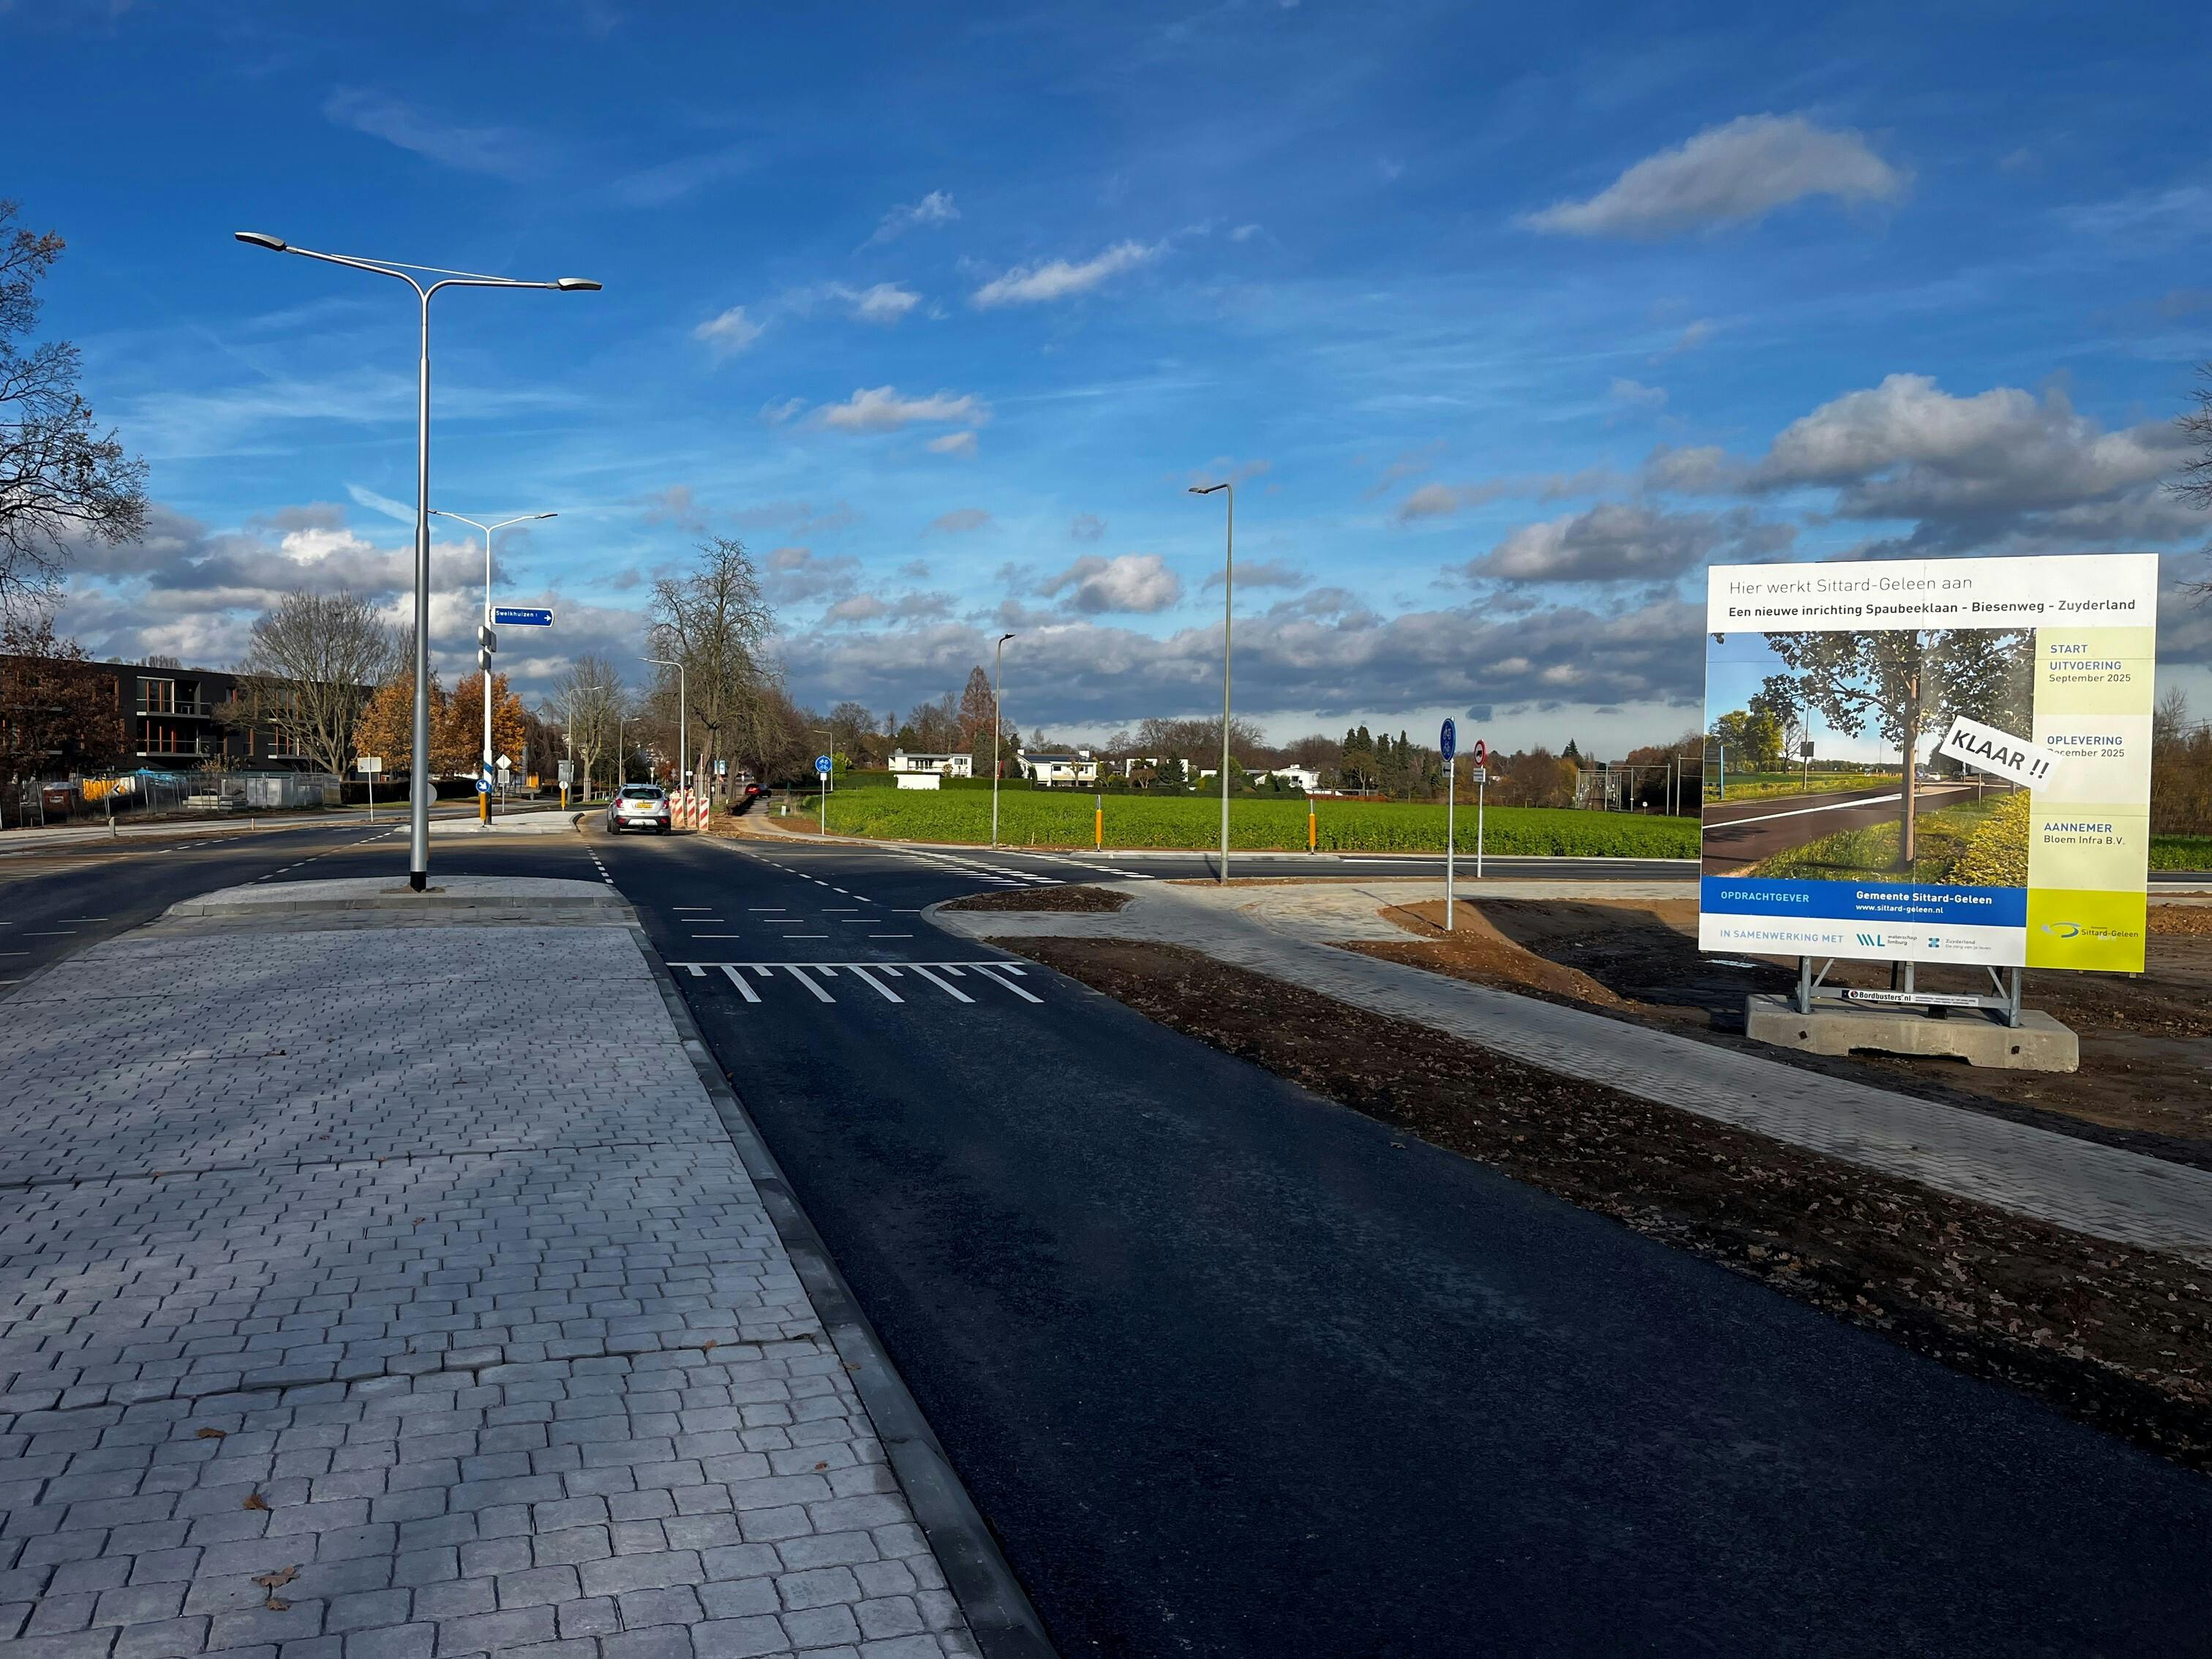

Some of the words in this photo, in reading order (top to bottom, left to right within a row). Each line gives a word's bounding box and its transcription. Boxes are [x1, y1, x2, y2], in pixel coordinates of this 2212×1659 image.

[1729, 581, 1763, 594] Hier
[1767, 580, 1812, 593] werkt
[1816, 576, 1936, 592] Sittard-Geleen
[1941, 578, 1973, 590] aan
[1728, 607, 1751, 617] Een
[1755, 606, 1799, 617] nieuwe
[1802, 604, 1862, 617] inrichting
[1865, 602, 1958, 616] Spaubeeklaan
[1971, 601, 2045, 614] Biesenweg
[2058, 599, 2136, 613] Zuyderland
[2050, 644, 2088, 653] START
[2050, 661, 2122, 671] UITVOERING
[2049, 674, 2104, 684] September
[2107, 674, 2132, 682] 2025
[2047, 736, 2123, 745] OPLEVERING
[1951, 729, 2025, 770] KLAAR
[2029, 759, 2050, 779] !!
[2101, 748, 2125, 757] 2025
[2044, 822, 2113, 832] AANNEMER
[2044, 835, 2076, 843] Bloem
[2079, 836, 2102, 844] Infra
[2106, 836, 2126, 845] B.V.
[1720, 891, 1810, 903] OPDRACHTGEVER
[1856, 890, 1910, 901] Gemeente
[1912, 892, 1993, 904] Sittard-Geleen
[1855, 903, 1944, 914] www.sittard-geleen.nl
[1734, 930, 1818, 941] SAMENWERKING
[1821, 934, 1844, 943] MET
[2081, 929, 2139, 938] Sittard-Geleen
